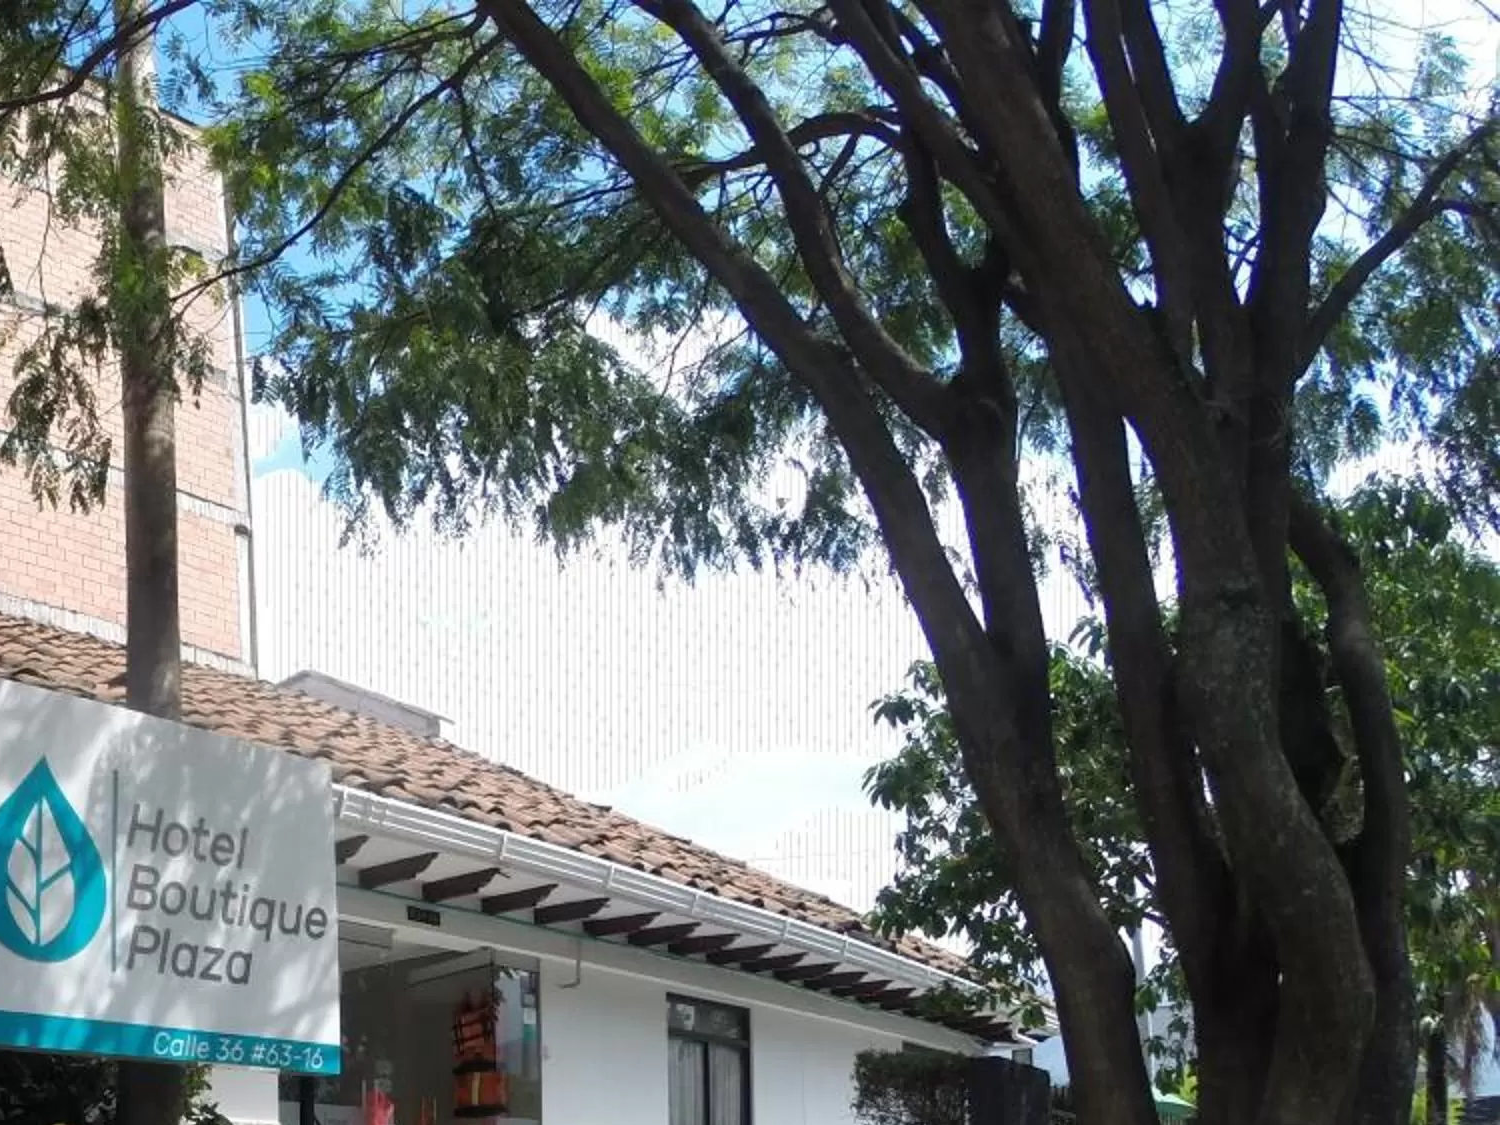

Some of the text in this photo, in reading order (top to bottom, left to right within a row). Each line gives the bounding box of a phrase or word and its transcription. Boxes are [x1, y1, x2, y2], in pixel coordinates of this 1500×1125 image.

[126, 803, 249, 869] Hotel
[126, 863, 329, 942] Boutique
[126, 924, 253, 985] Plaza
[153, 1031, 324, 1069] Calle 36 #63-16
